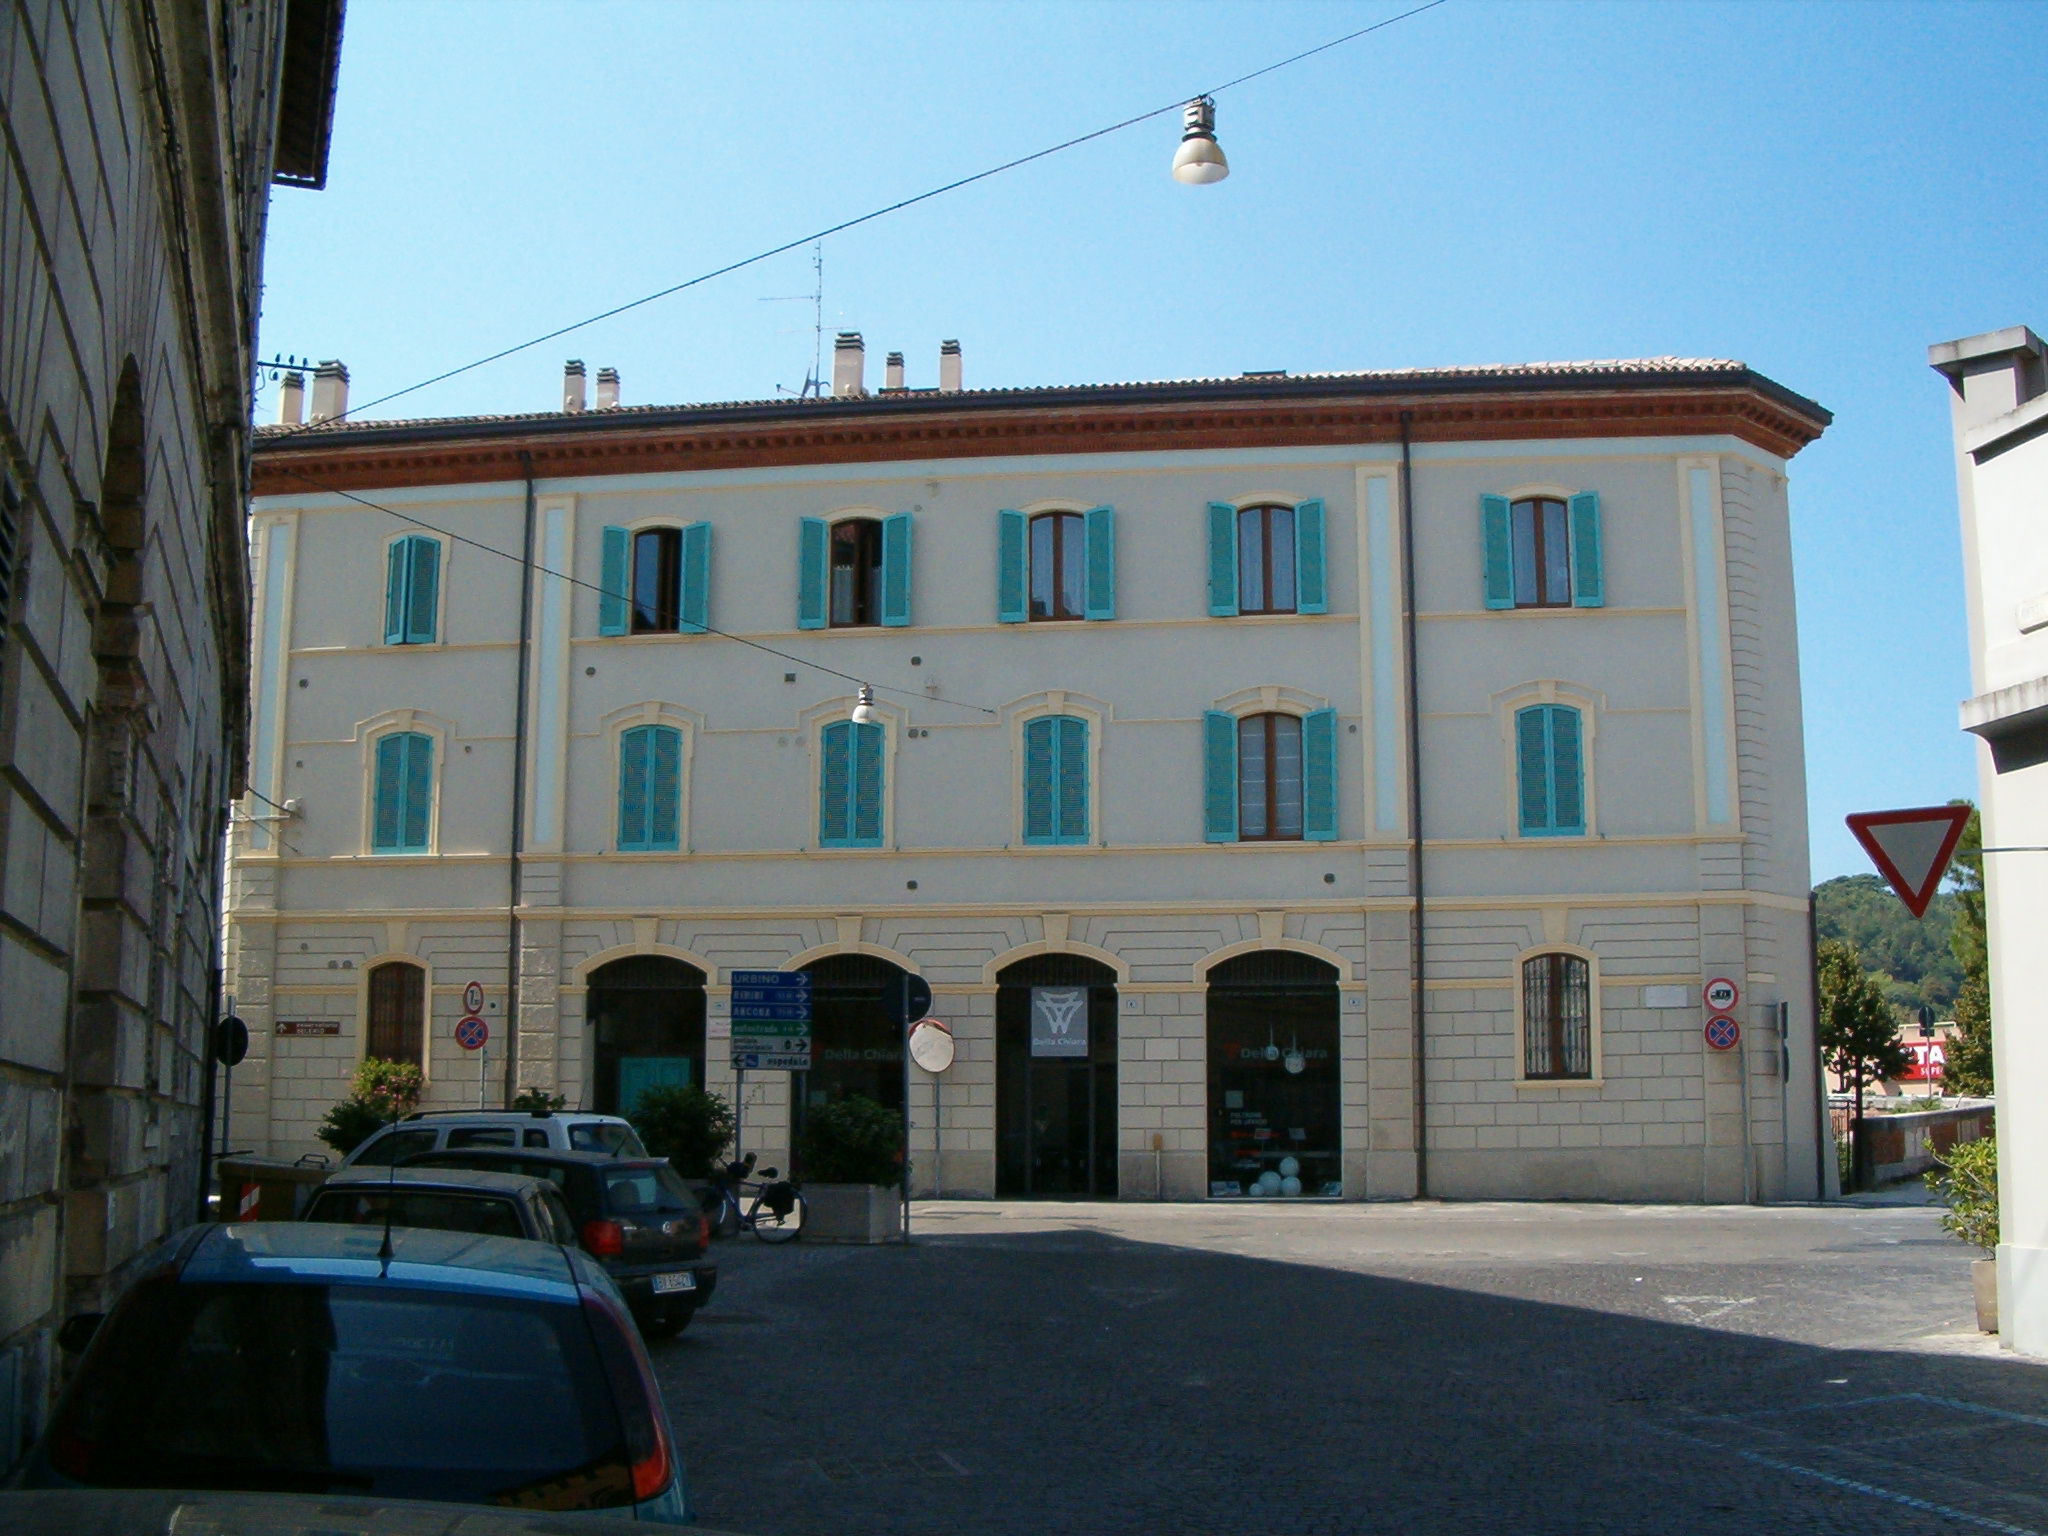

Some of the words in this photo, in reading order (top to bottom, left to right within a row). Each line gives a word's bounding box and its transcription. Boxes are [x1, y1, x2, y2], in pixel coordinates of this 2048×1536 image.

[733, 974, 780, 984] URBINO
[733, 990, 764, 1000] RIMINI
[733, 1007, 771, 1016] ANCONA
[734, 1024, 778, 1033] autostrada
[766, 1055, 808, 1066] ospedale
